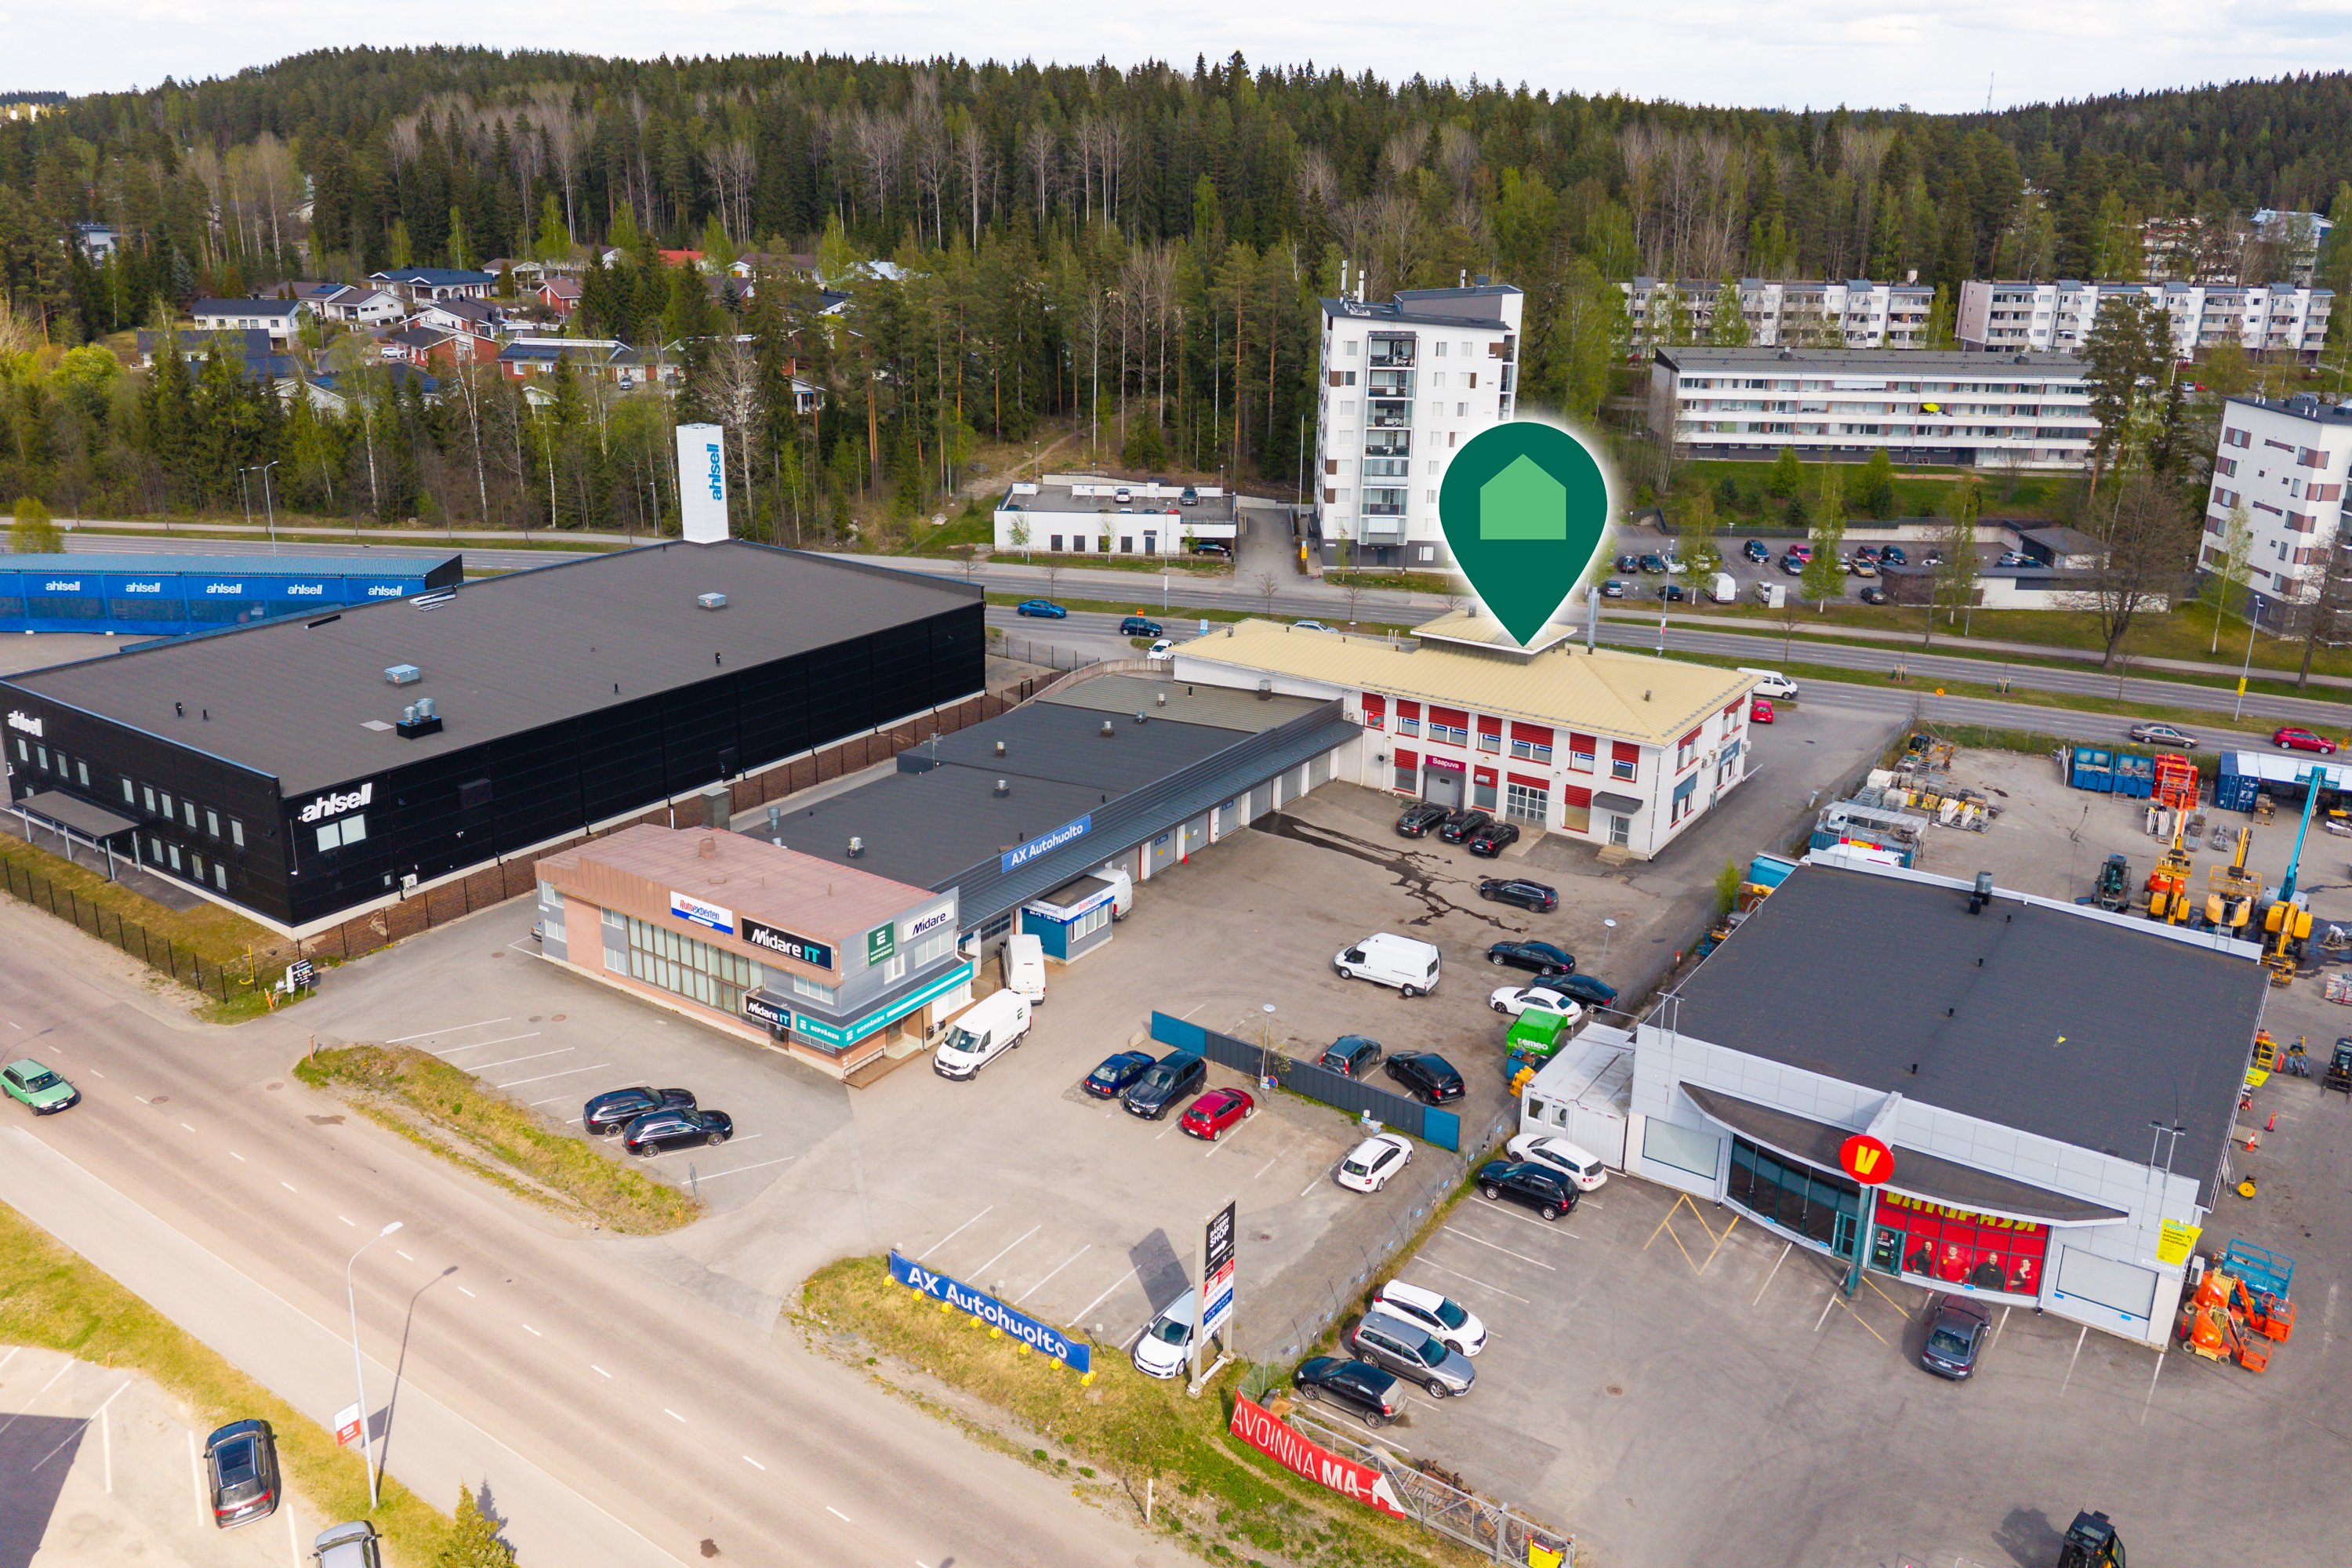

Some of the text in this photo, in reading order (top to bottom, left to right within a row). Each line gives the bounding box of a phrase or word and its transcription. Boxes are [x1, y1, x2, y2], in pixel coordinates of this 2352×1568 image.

[706, 444, 722, 500] ahlsell
[45, 581, 80, 591] ahlsell
[125, 583, 161, 593] ahlsell
[206, 583, 241, 594] ahlsell
[288, 584, 322, 595] ahlsell
[368, 586, 402, 596] ahlsell
[8, 710, 42, 737] ahlsell
[1432, 757, 1459, 769] Saapuva
[301, 782, 372, 822] ahlsell
[1011, 825, 1083, 866] AX Autohuolto
[680, 899, 720, 921] Autoexperten
[913, 913, 946, 936] Midare
[751, 927, 820, 963] Midare IT
[748, 1002, 789, 1025] Midare IT
[1854, 1145, 1881, 1175] V
[1209, 1224, 1229, 1248] SHOP
[1210, 1215, 1230, 1239] BAKERY
[907, 1266, 1068, 1359] AX Autohuolto
[1231, 1401, 1317, 1480] AVOINNA
